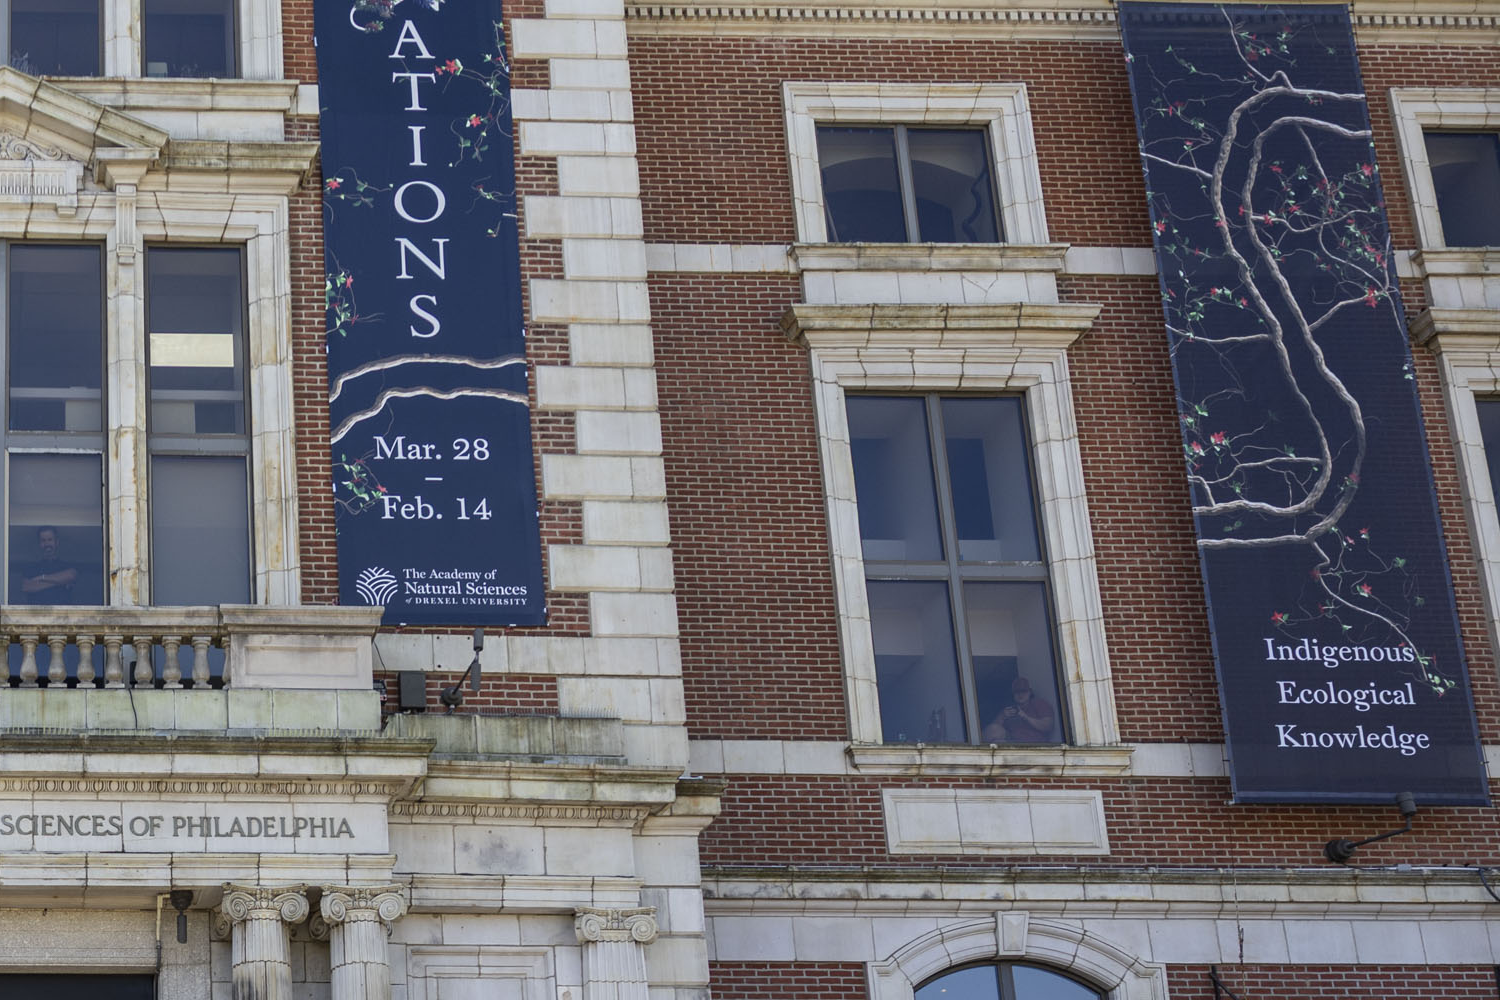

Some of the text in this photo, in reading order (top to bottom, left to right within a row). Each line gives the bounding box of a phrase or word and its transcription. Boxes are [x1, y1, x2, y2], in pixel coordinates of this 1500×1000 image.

[366, 0, 450, 338] ATIONS
[373, 436, 490, 461] Mar. 28
[381, 495, 492, 520] Feb. 14
[403, 568, 497, 582] The Academy of
[404, 581, 527, 596] Natural Sciences
[415, 597, 458, 605] DREXEL
[462, 597, 527, 606] UNIVERSITY
[1263, 637, 1415, 668] Indigenous
[1276, 680, 1416, 712] Ecological
[1275, 724, 1430, 756] Knowledge
[0, 814, 123, 837] SCIENCES
[129, 815, 164, 837] OF
[172, 816, 355, 839] PHILADELPHIA
